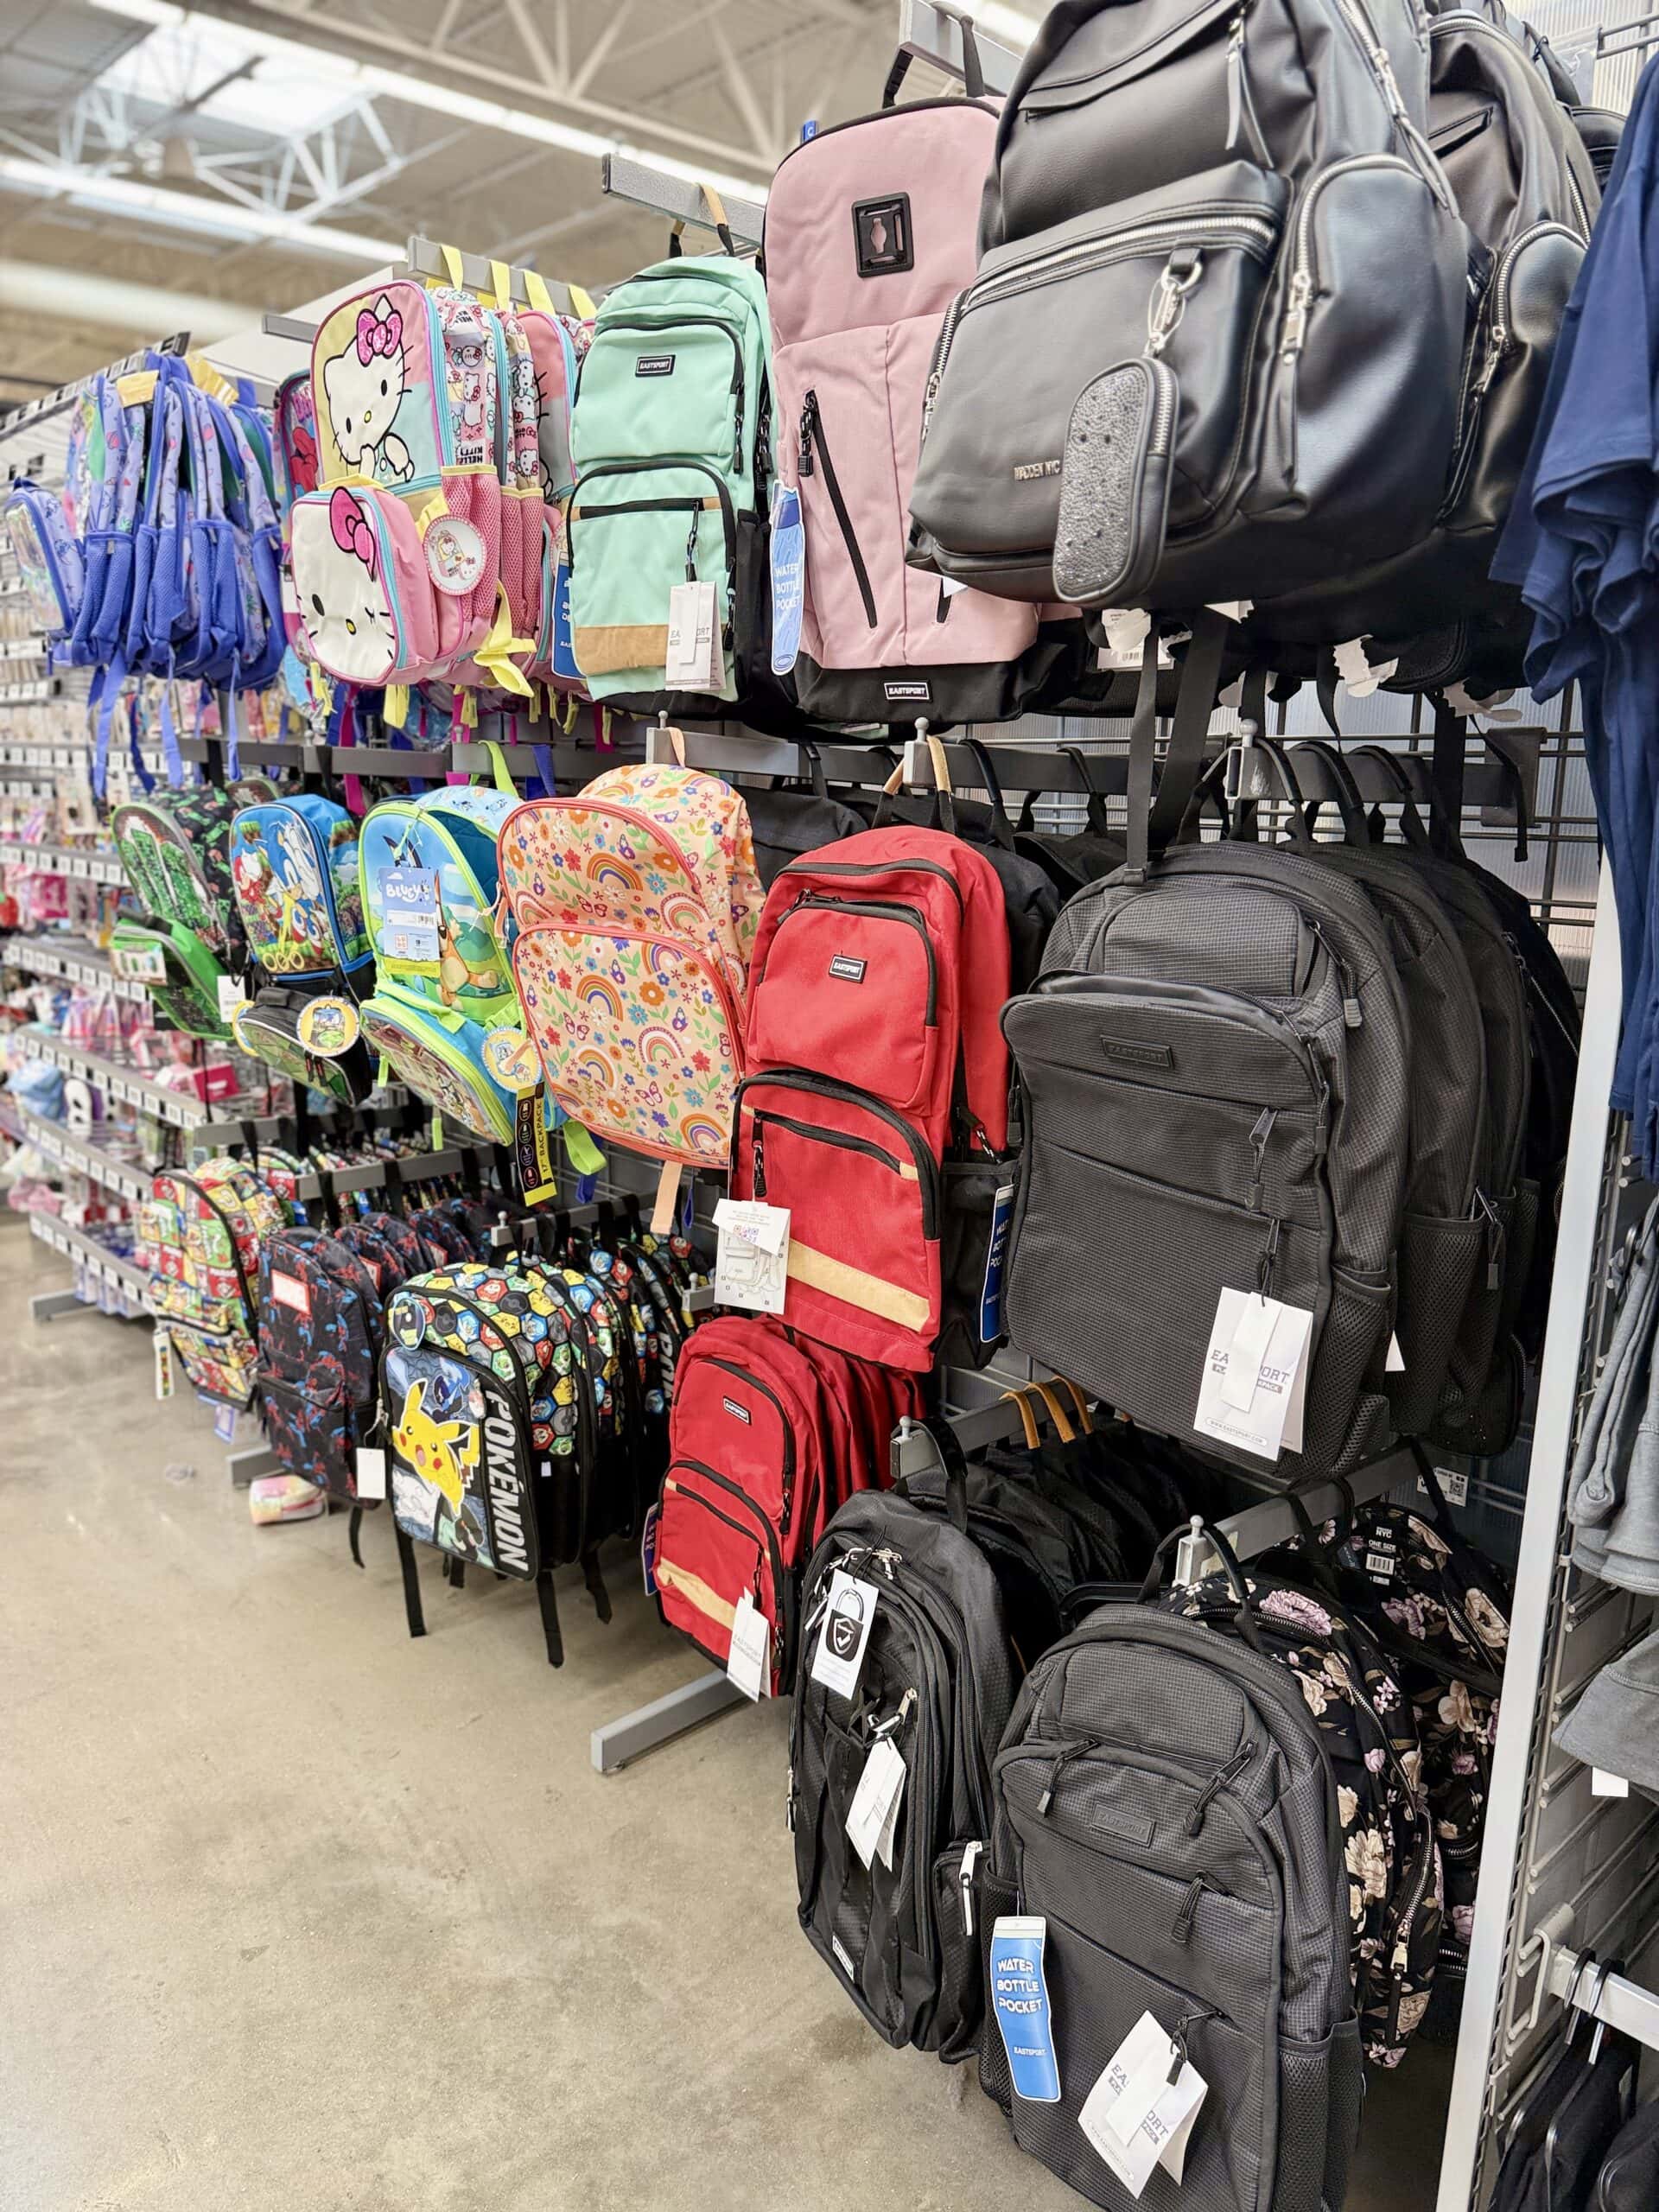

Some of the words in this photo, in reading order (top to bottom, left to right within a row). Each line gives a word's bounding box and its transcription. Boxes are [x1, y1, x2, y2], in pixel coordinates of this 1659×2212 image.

[1368, 1539, 1382, 1548] ONE
[1382, 1542, 1396, 1552] SIZE
[997, 1958, 1034, 1974] WATER
[996, 1980, 1039, 1993] BOTTLE
[998, 1998, 1043, 2014] POCKET
